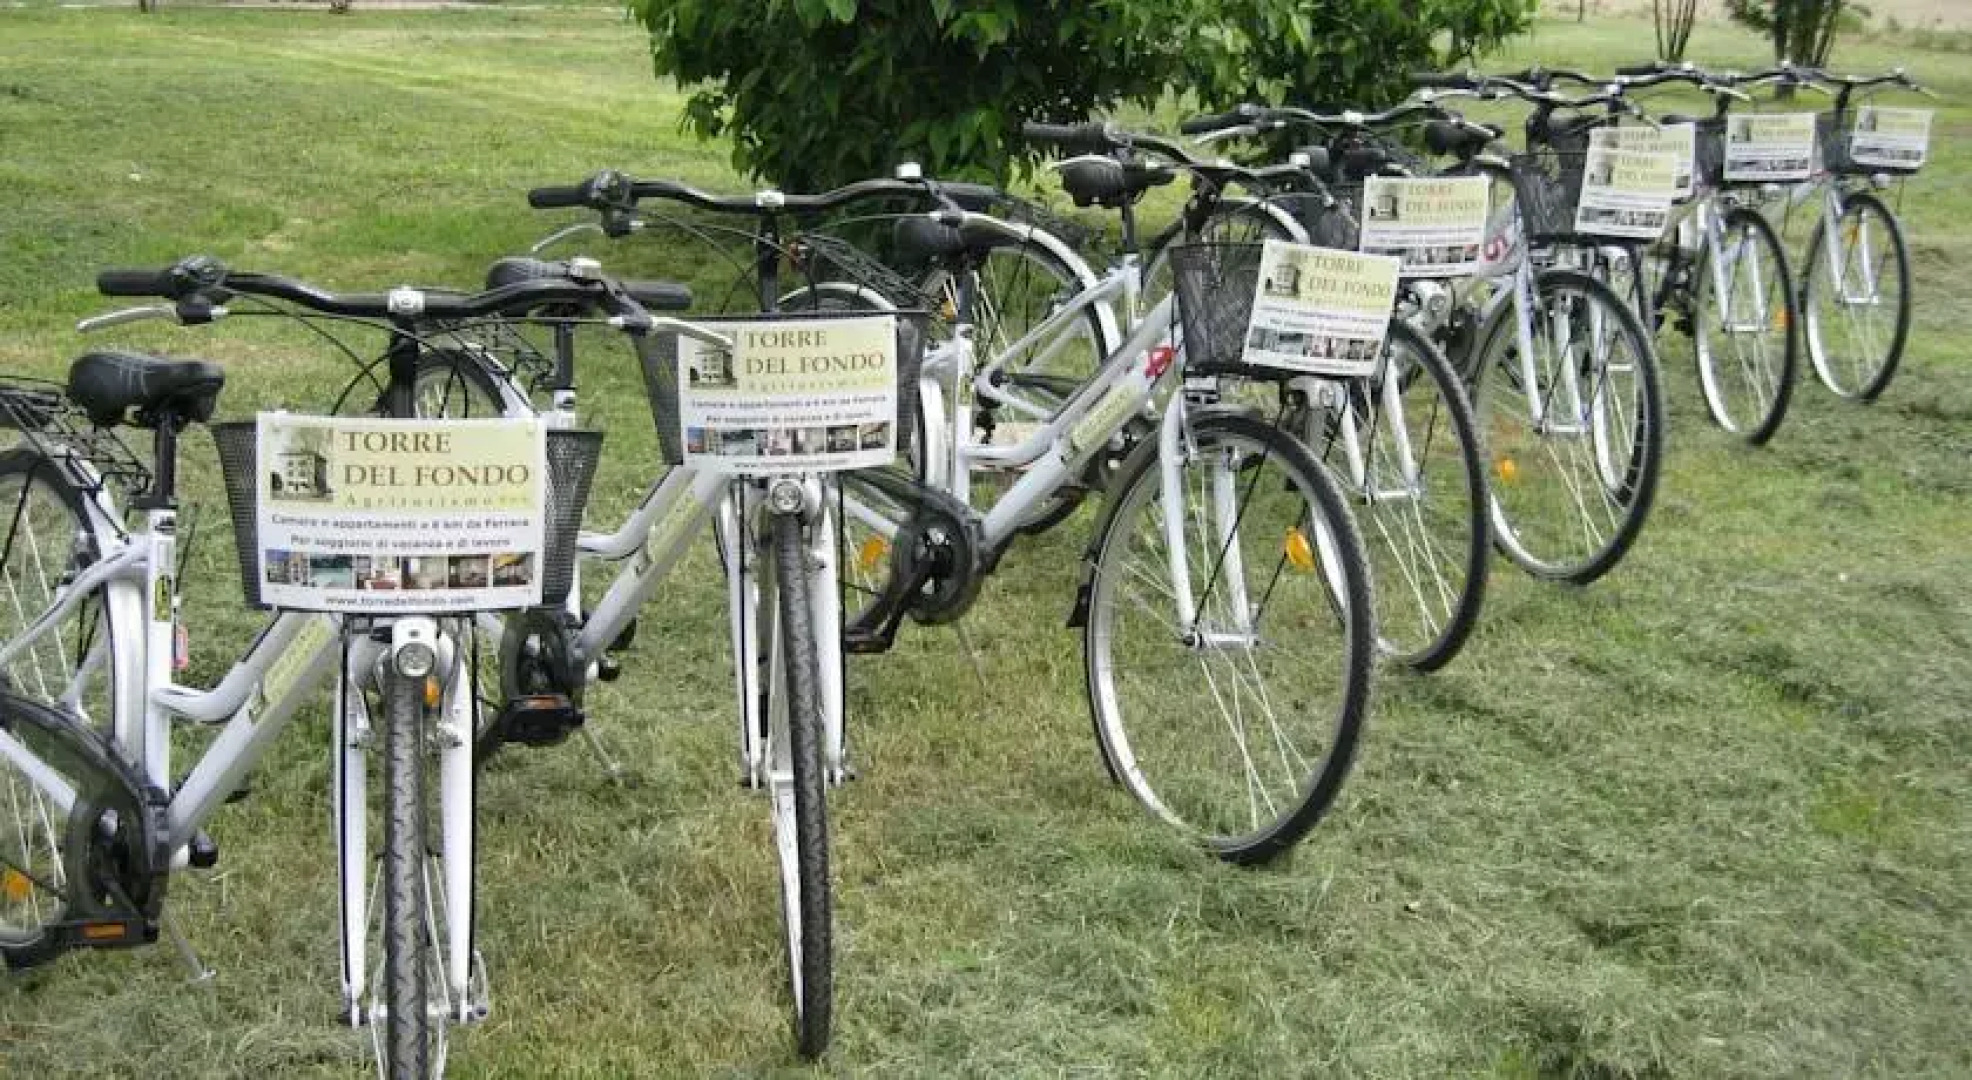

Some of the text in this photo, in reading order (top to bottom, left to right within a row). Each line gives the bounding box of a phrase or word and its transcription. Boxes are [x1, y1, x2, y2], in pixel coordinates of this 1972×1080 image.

[743, 330, 827, 349] TORRE
[746, 352, 885, 374] DEL FONDO
[341, 431, 452, 453] TORRE
[344, 463, 529, 487] DEL FONDO
